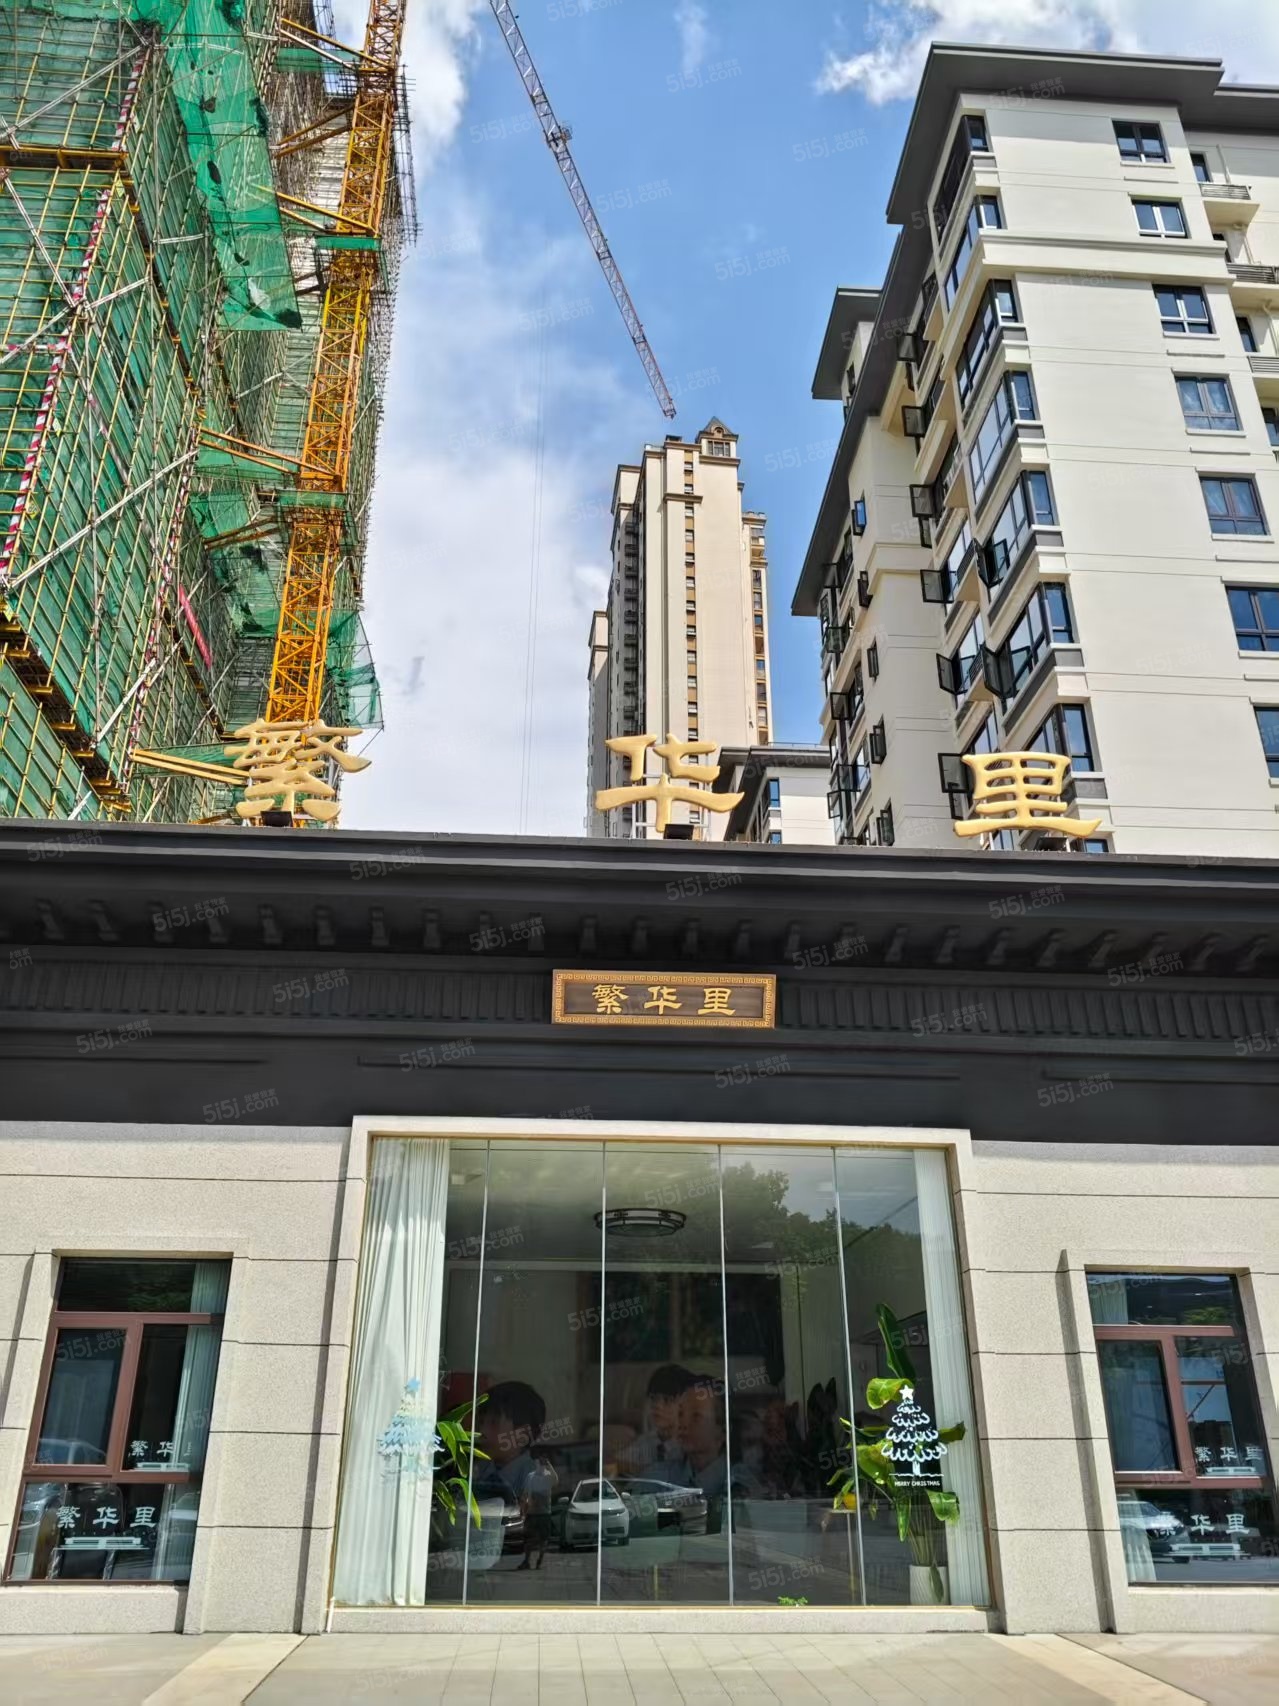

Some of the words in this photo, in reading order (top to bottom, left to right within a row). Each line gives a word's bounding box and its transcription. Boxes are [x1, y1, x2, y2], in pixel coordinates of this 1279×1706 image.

[224, 719, 1102, 838] 繁华里
[592, 984, 735, 1015] 繁华里
[56, 1506, 158, 1529] 繁华里
